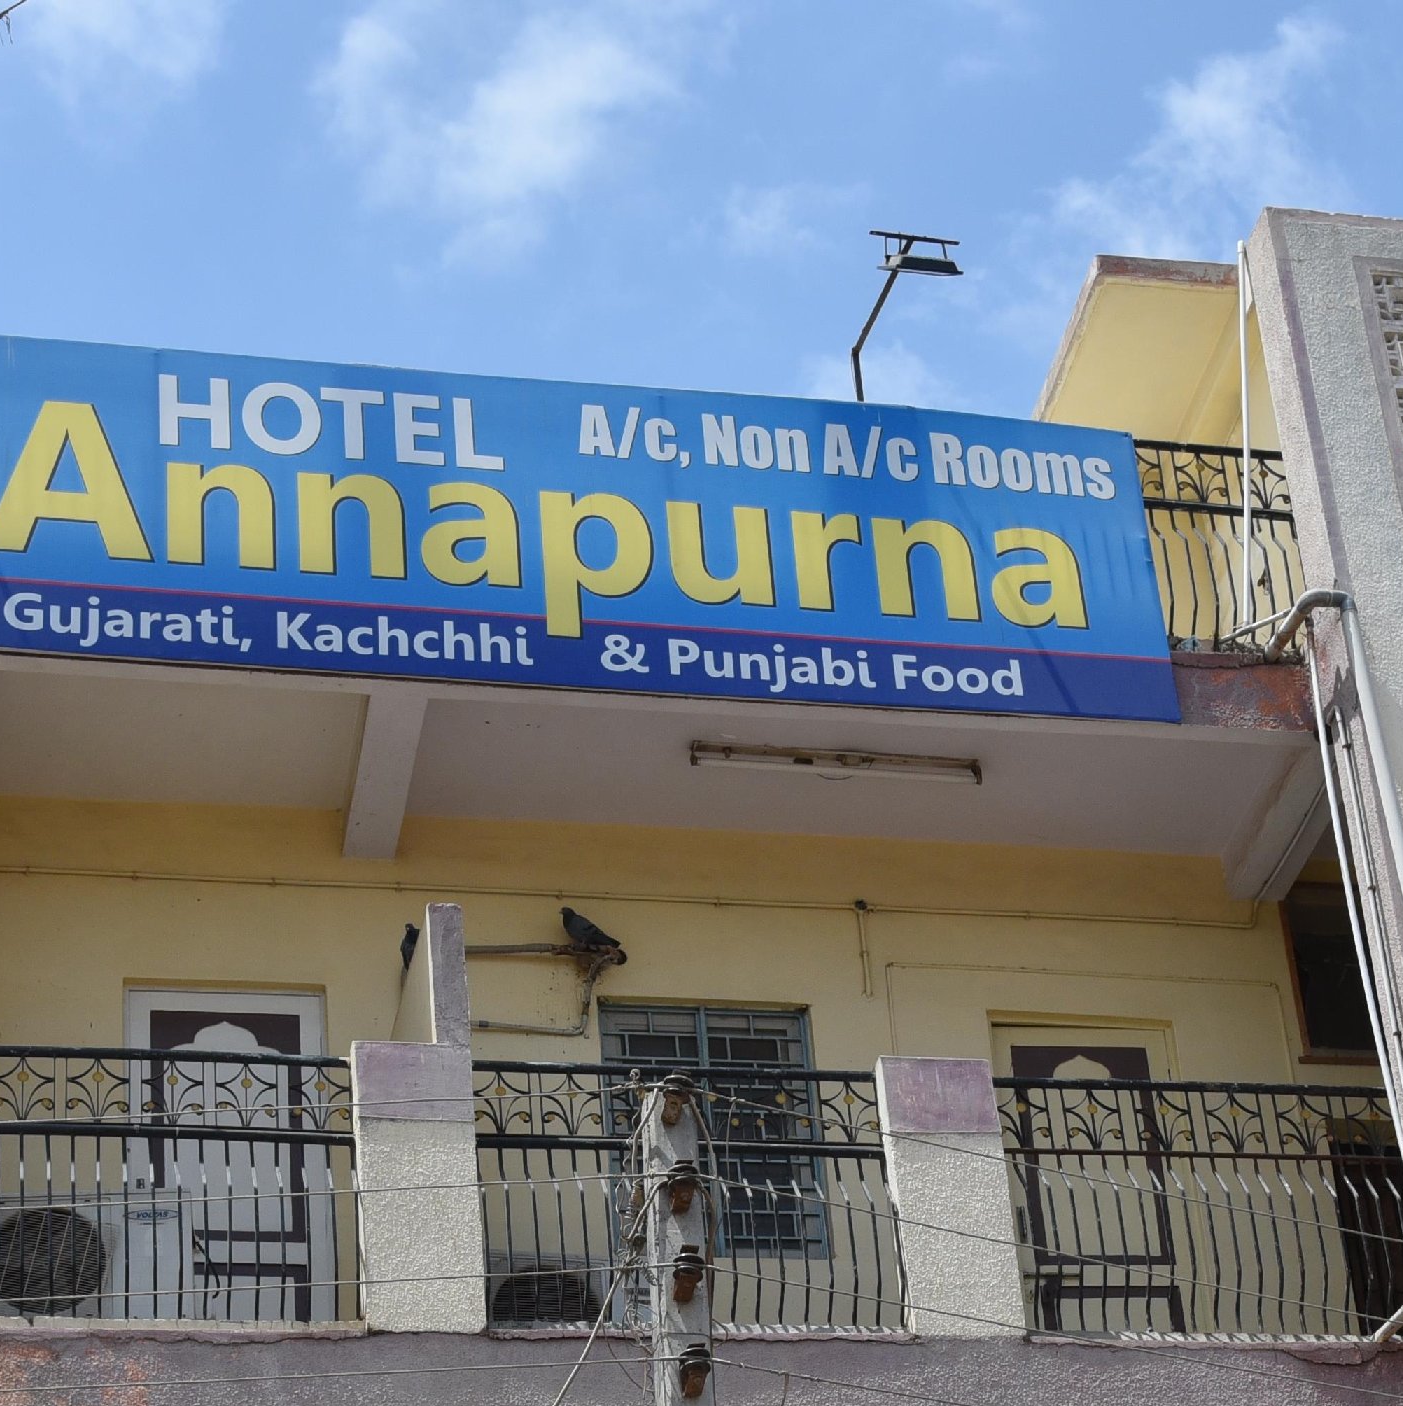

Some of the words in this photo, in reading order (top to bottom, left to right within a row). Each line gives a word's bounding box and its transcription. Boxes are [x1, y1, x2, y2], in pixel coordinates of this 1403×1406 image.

[158, 373, 505, 471] HOTEL
[578, 404, 691, 468] A/c,
[701, 413, 811, 473] Non
[824, 423, 920, 482] A/c
[929, 432, 1116, 500] Rooms
[3, 592, 252, 652] Gujarati,
[276, 611, 534, 666] Kachchhi
[600, 634, 649, 673] &
[668, 638, 877, 693] Punjabi
[893, 654, 1024, 697] Food
[137, 1211, 169, 1219] VOLAS
